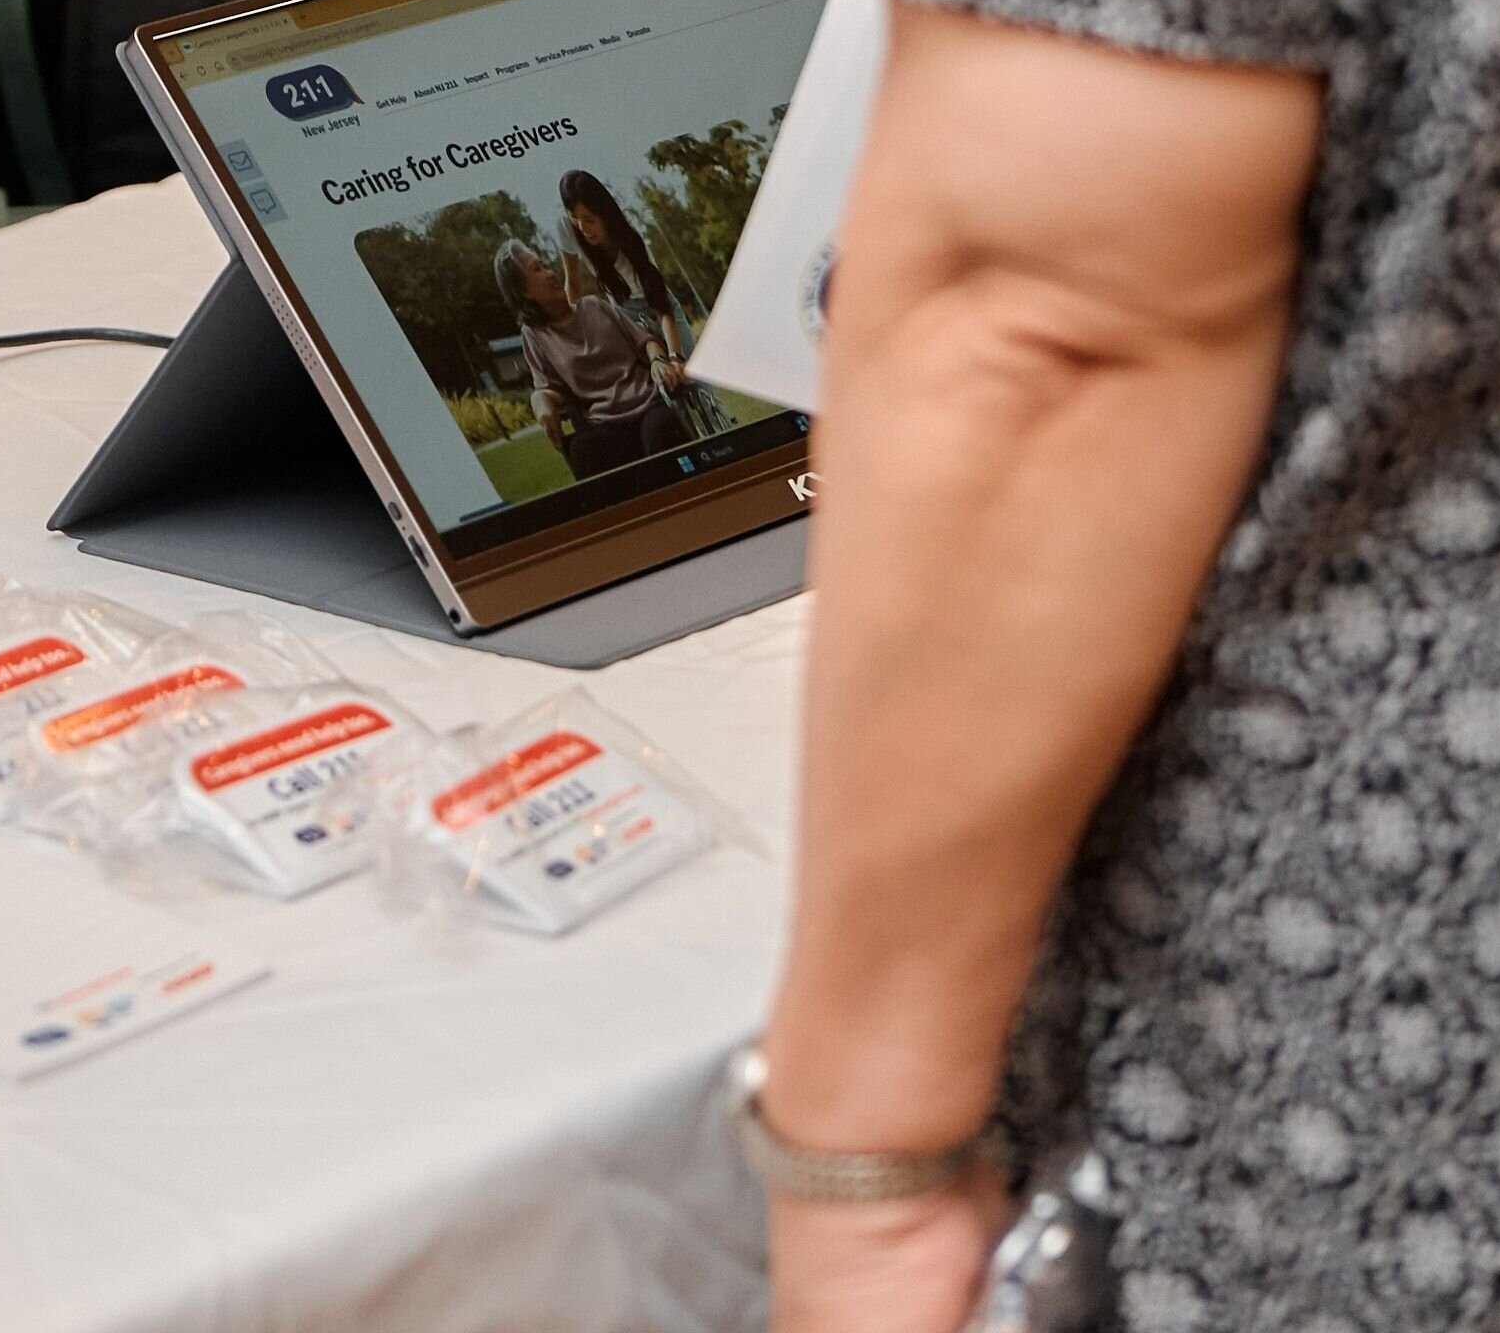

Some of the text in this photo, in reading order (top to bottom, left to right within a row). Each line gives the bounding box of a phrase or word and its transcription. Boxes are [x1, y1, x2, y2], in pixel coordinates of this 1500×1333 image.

[414, 86, 436, 99] About
[445, 79, 459, 90] 211
[494, 60, 531, 76] Programs
[535, 51, 561, 64] Service
[560, 42, 595, 57] Providers
[301, 112, 361, 138] New Jersey
[321, 116, 579, 206] Caring for Caregivers
[267, 764, 323, 801] Call
